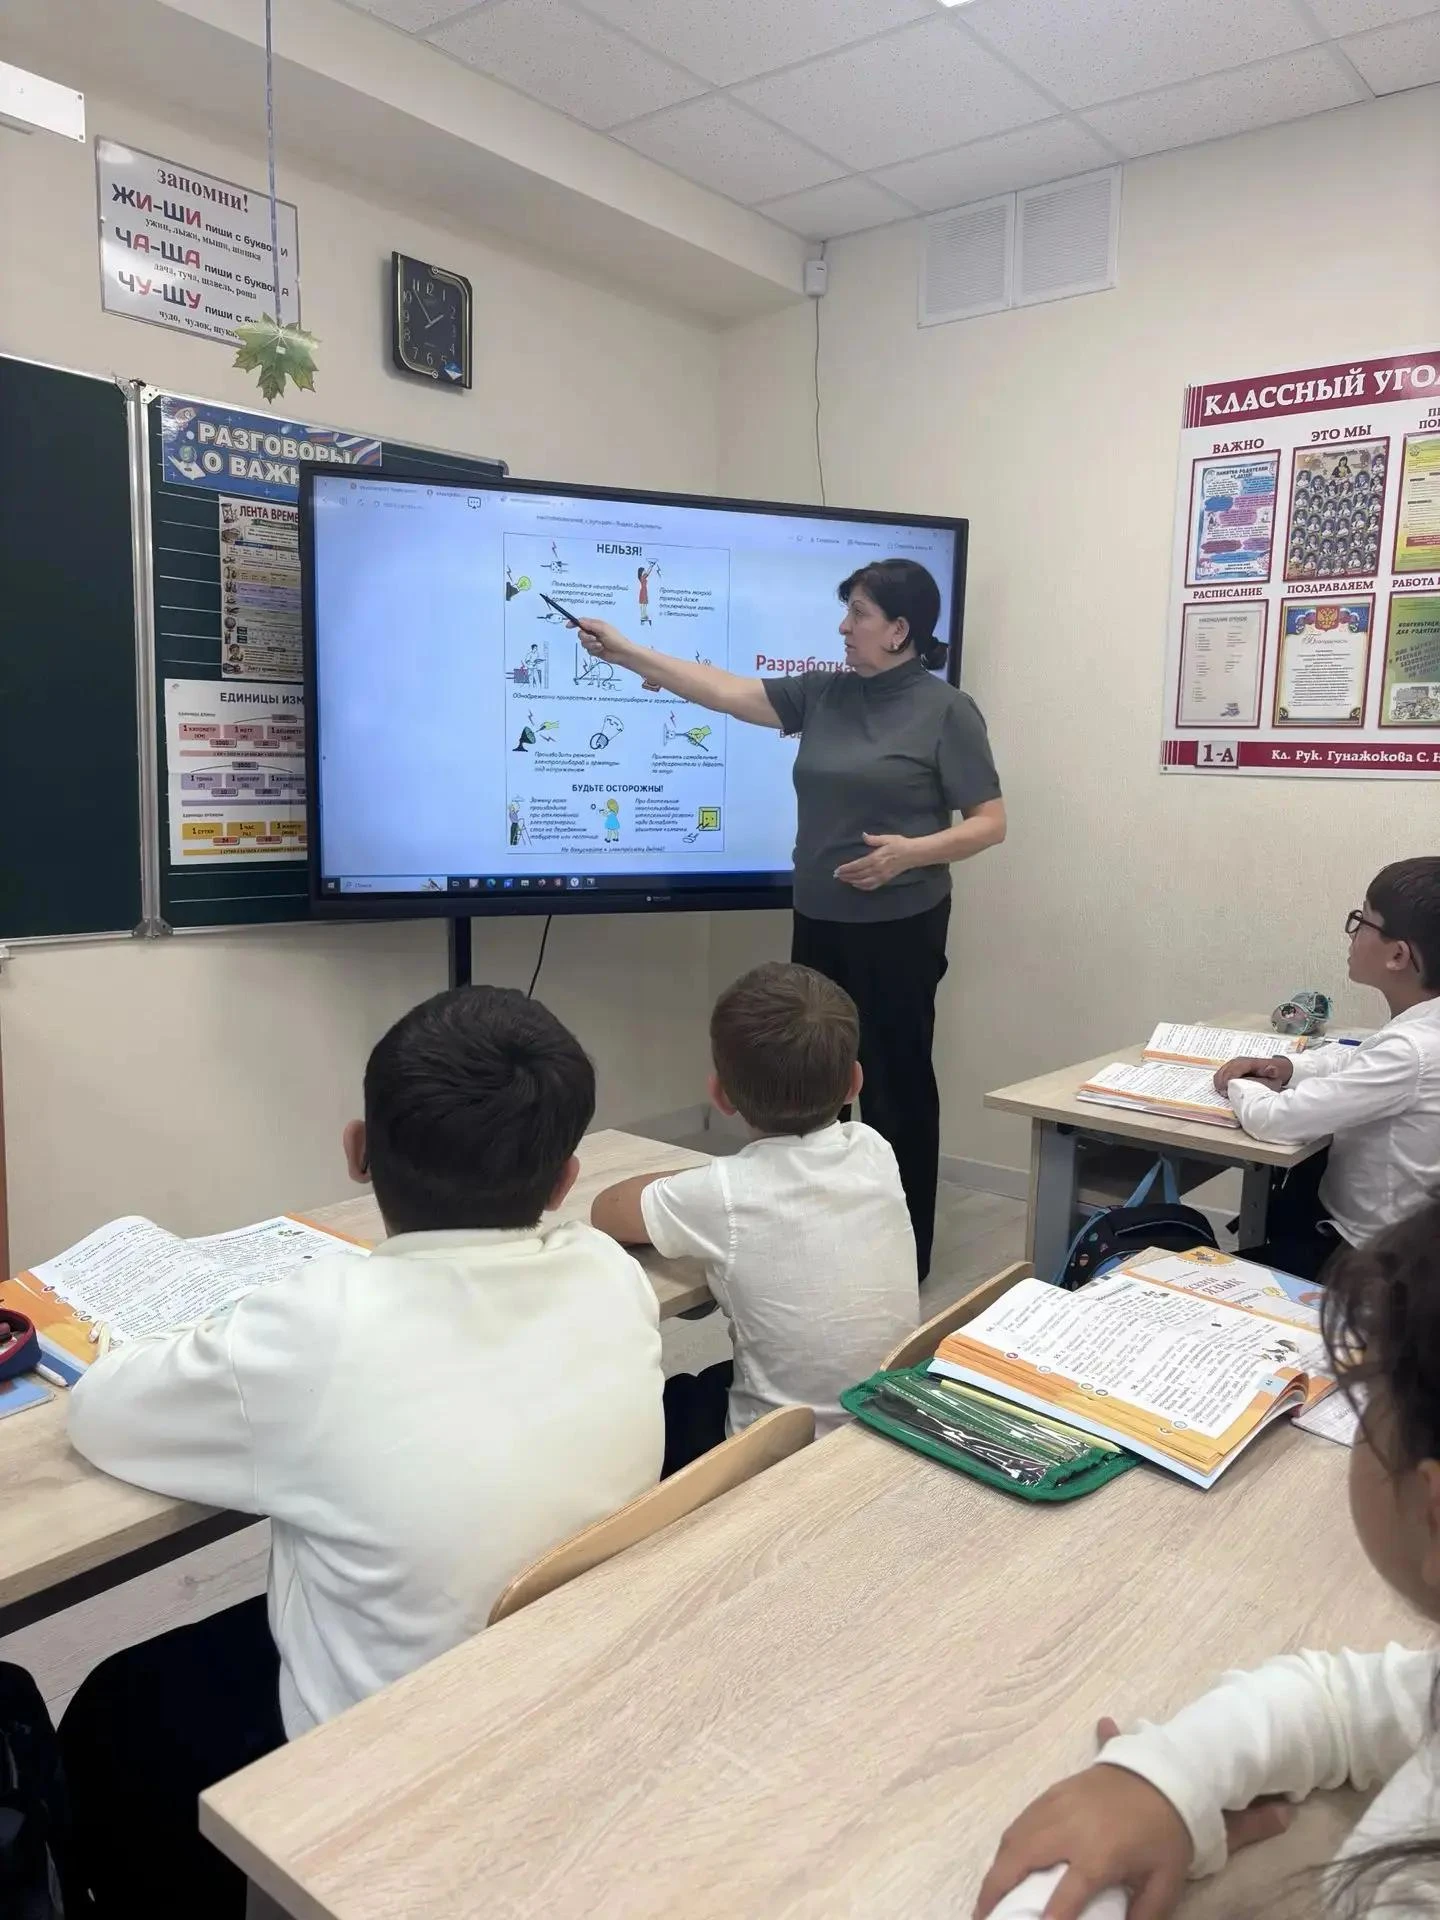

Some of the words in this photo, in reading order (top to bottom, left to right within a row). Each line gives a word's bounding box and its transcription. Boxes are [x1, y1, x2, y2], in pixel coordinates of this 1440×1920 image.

[112, 183, 201, 228] ЖИ-ШИ
[205, 223, 232, 239] пиши
[235, 234, 241, 242] с
[244, 235, 276, 252] букво
[115, 226, 200, 269] ЧА-ЩА
[204, 264, 232, 280] пиши
[235, 274, 241, 282] с
[119, 270, 201, 309] ЧУ-ЩУ
[204, 305, 233, 320] пиши
[1203, 367, 1367, 417] КЛАССНЫЙ
[1372, 363, 1440, 396] УГО
[1310, 428, 1340, 442] ЭТО
[1343, 424, 1372, 437] МЫ
[197, 421, 352, 464] РАЗГОВОРЫ
[1212, 438, 1265, 454] ВАЖНО
[202, 450, 223, 474] О
[228, 456, 299, 487] ВАЖН
[239, 505, 269, 519] ЛЕНТА
[596, 543, 642, 556] НЕЛЬЗЯ!
[1287, 580, 1374, 594] ПОЗДРАВЛЯЕМ
[1391, 577, 1435, 588] РАБОТА
[1193, 587, 1263, 600] РАСПИСАНИЕ
[220, 692, 279, 705] ЕДИНИЦЫ
[1203, 743, 1234, 763] 1-А
[1271, 749, 1291, 761] Кл.
[1296, 750, 1323, 764] Рук.
[1327, 750, 1413, 765] Гунажокова
[1416, 751, 1430, 763] С.
[572, 784, 604, 793] БУДЬТЕ
[605, 785, 664, 793] ОСТОРОЖНЫ!
